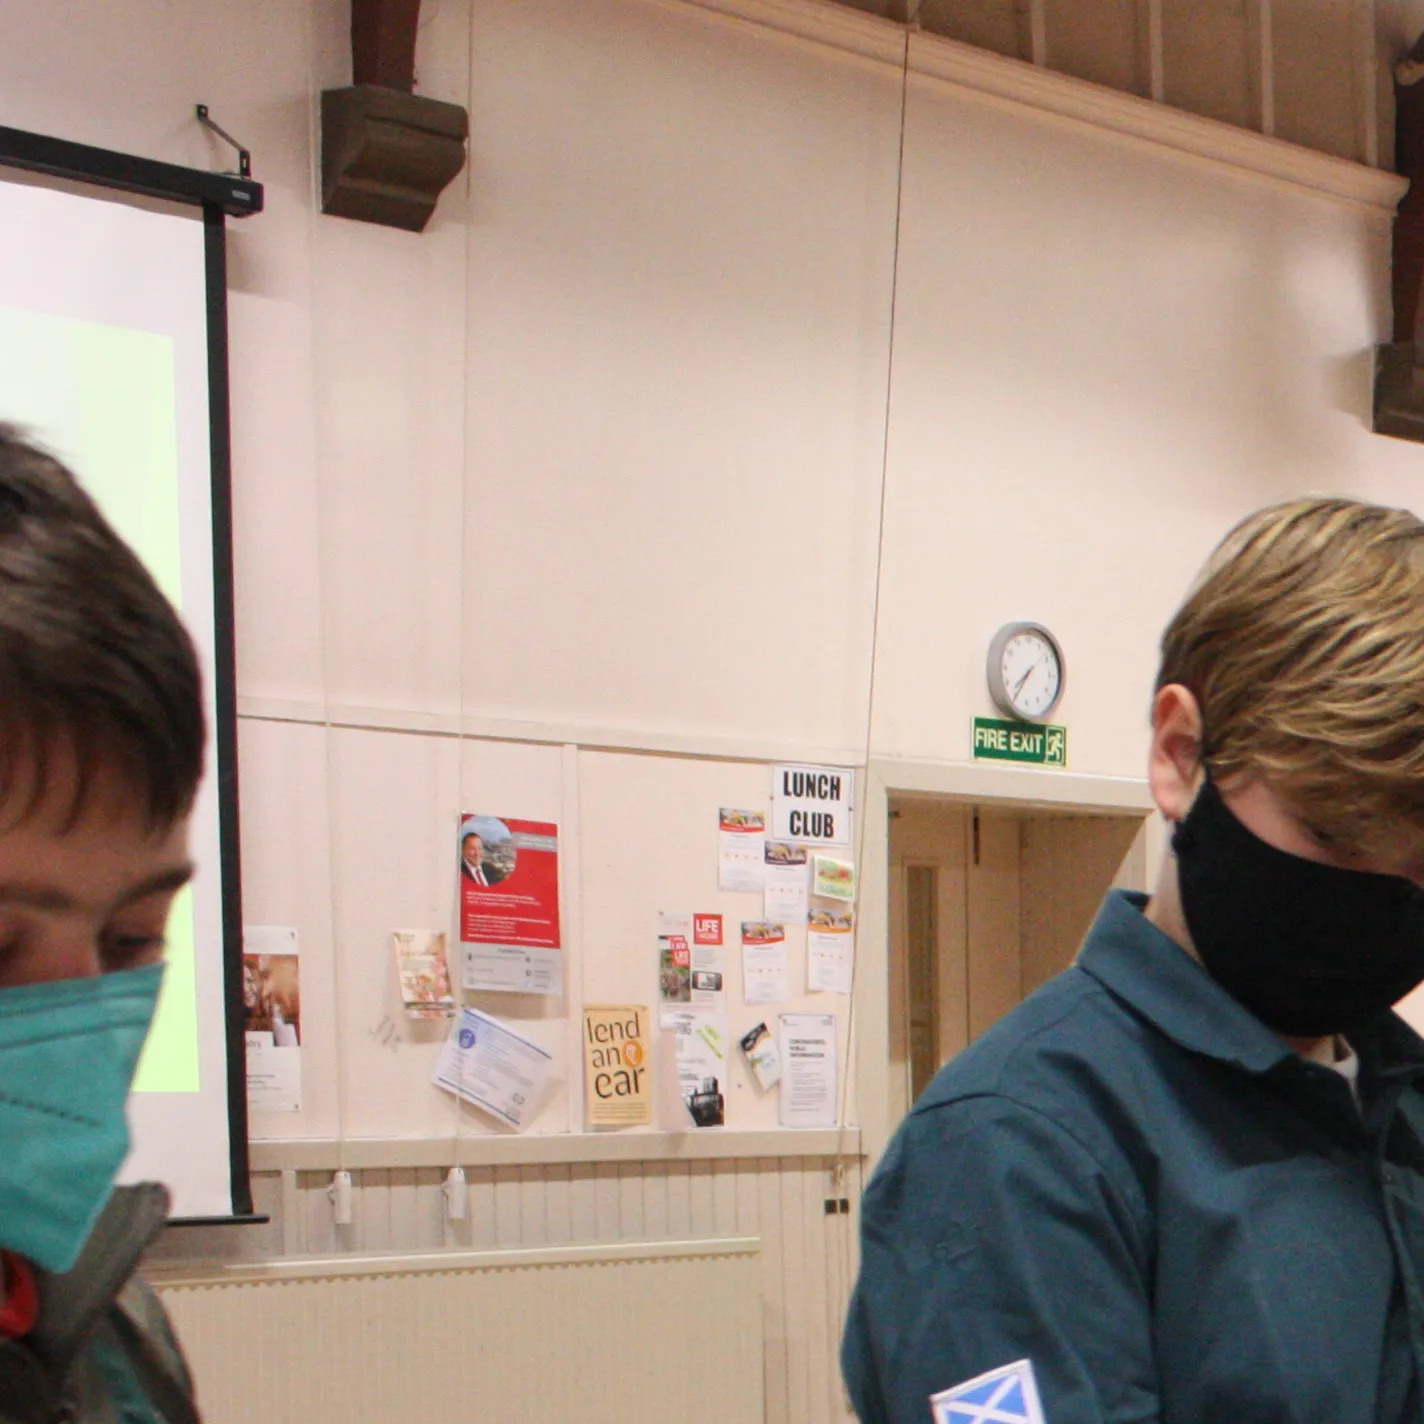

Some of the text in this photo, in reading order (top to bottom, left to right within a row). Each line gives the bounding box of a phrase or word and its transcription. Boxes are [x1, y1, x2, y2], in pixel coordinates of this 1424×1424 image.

[975, 727, 1043, 753] FIRE EXIT
[782, 770, 841, 801] LUNCH
[789, 810, 835, 839] CLUB
[695, 919, 720, 933] LIFE
[586, 1011, 641, 1044] lend
[591, 1046, 621, 1069] an
[594, 1067, 646, 1099] ear
